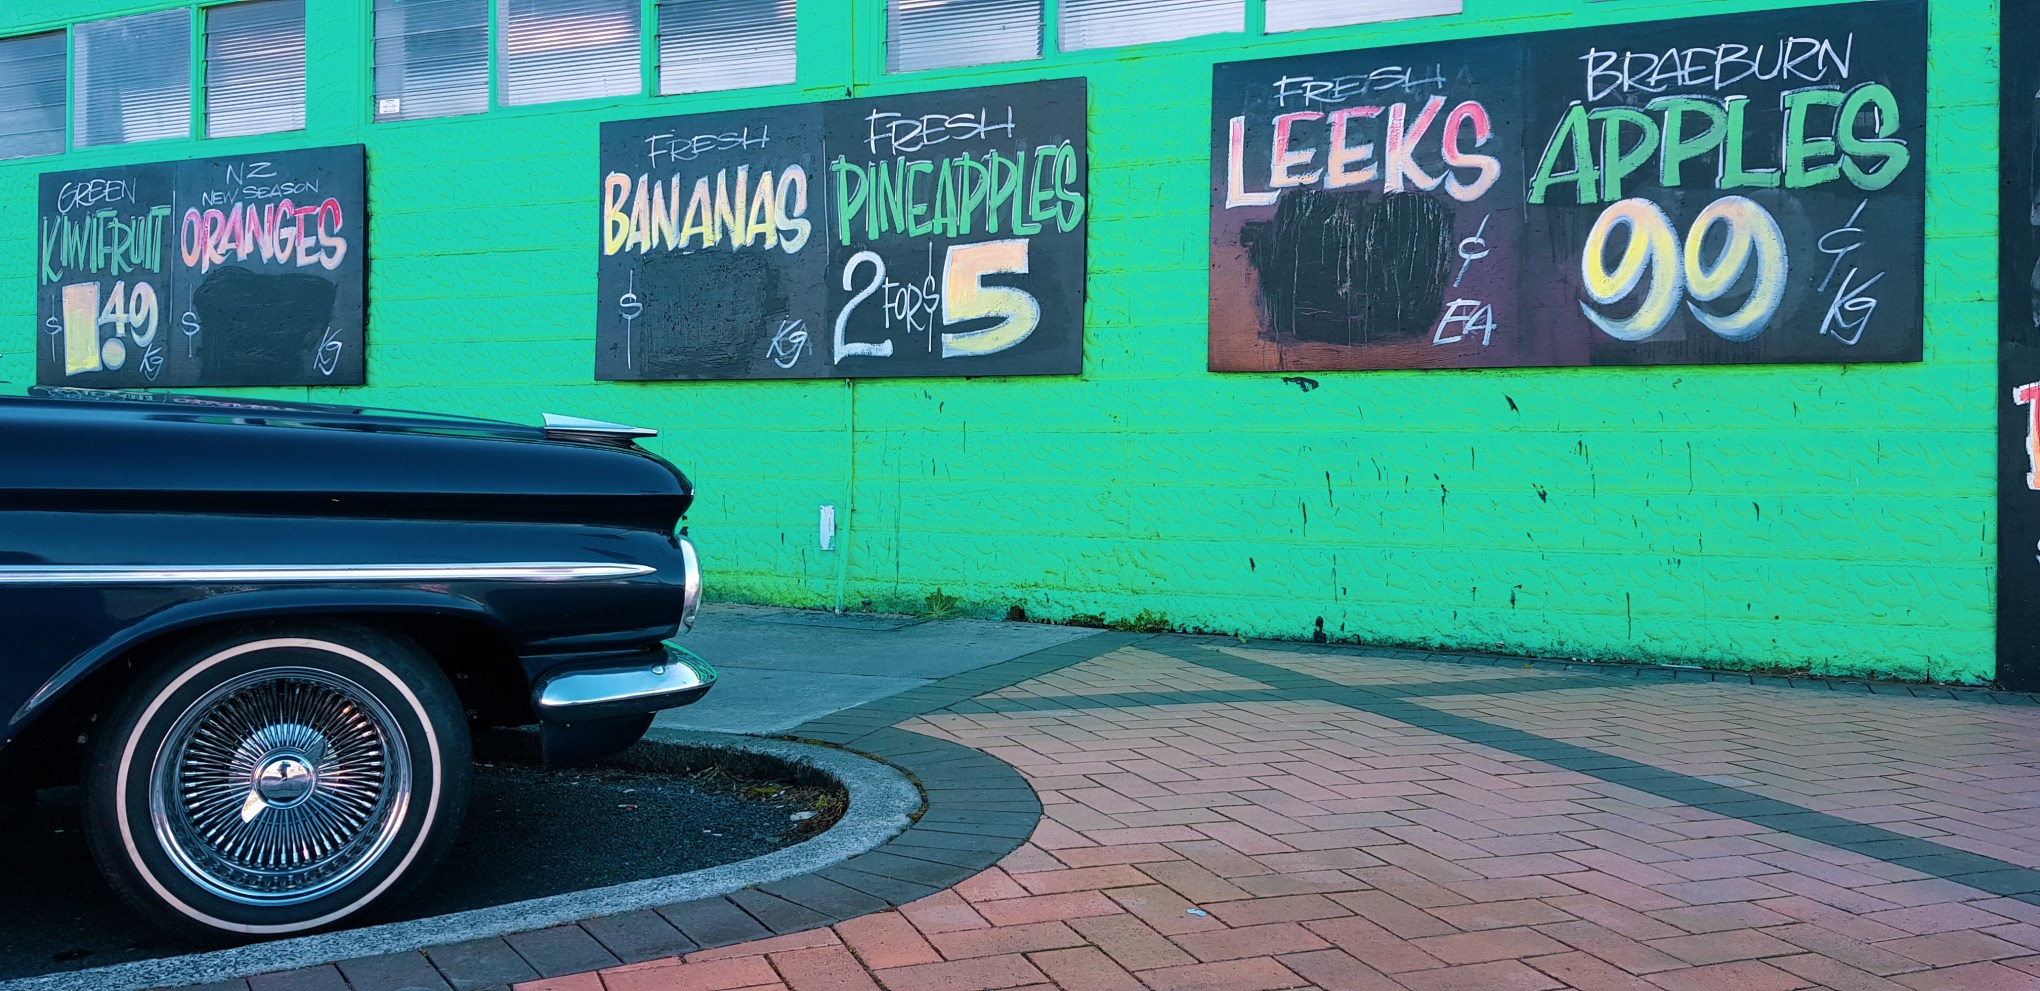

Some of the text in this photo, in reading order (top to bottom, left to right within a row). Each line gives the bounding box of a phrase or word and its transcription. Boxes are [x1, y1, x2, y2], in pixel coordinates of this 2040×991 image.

[1273, 63, 1447, 106] FRESH
[1579, 32, 1853, 101] BRAEBURN
[645, 125, 770, 168] FRESH
[865, 105, 1015, 155] FRESH
[1225, 94, 1501, 209] LEEKS
[1527, 81, 1910, 204] APPLES
[58, 178, 136, 214] GREEN
[202, 179, 318, 206] NEW SEASON
[226, 162, 276, 185] NZ
[604, 163, 812, 256] BANANAS
[828, 140, 1085, 246] PINEAPPLES
[41, 204, 172, 286] KIWIFRUIT
[181, 197, 347, 274] ORANGES
[181, 282, 200, 358] $
[619, 269, 643, 370] $
[834, 250, 894, 365] 2
[1433, 298, 1498, 347] EA
